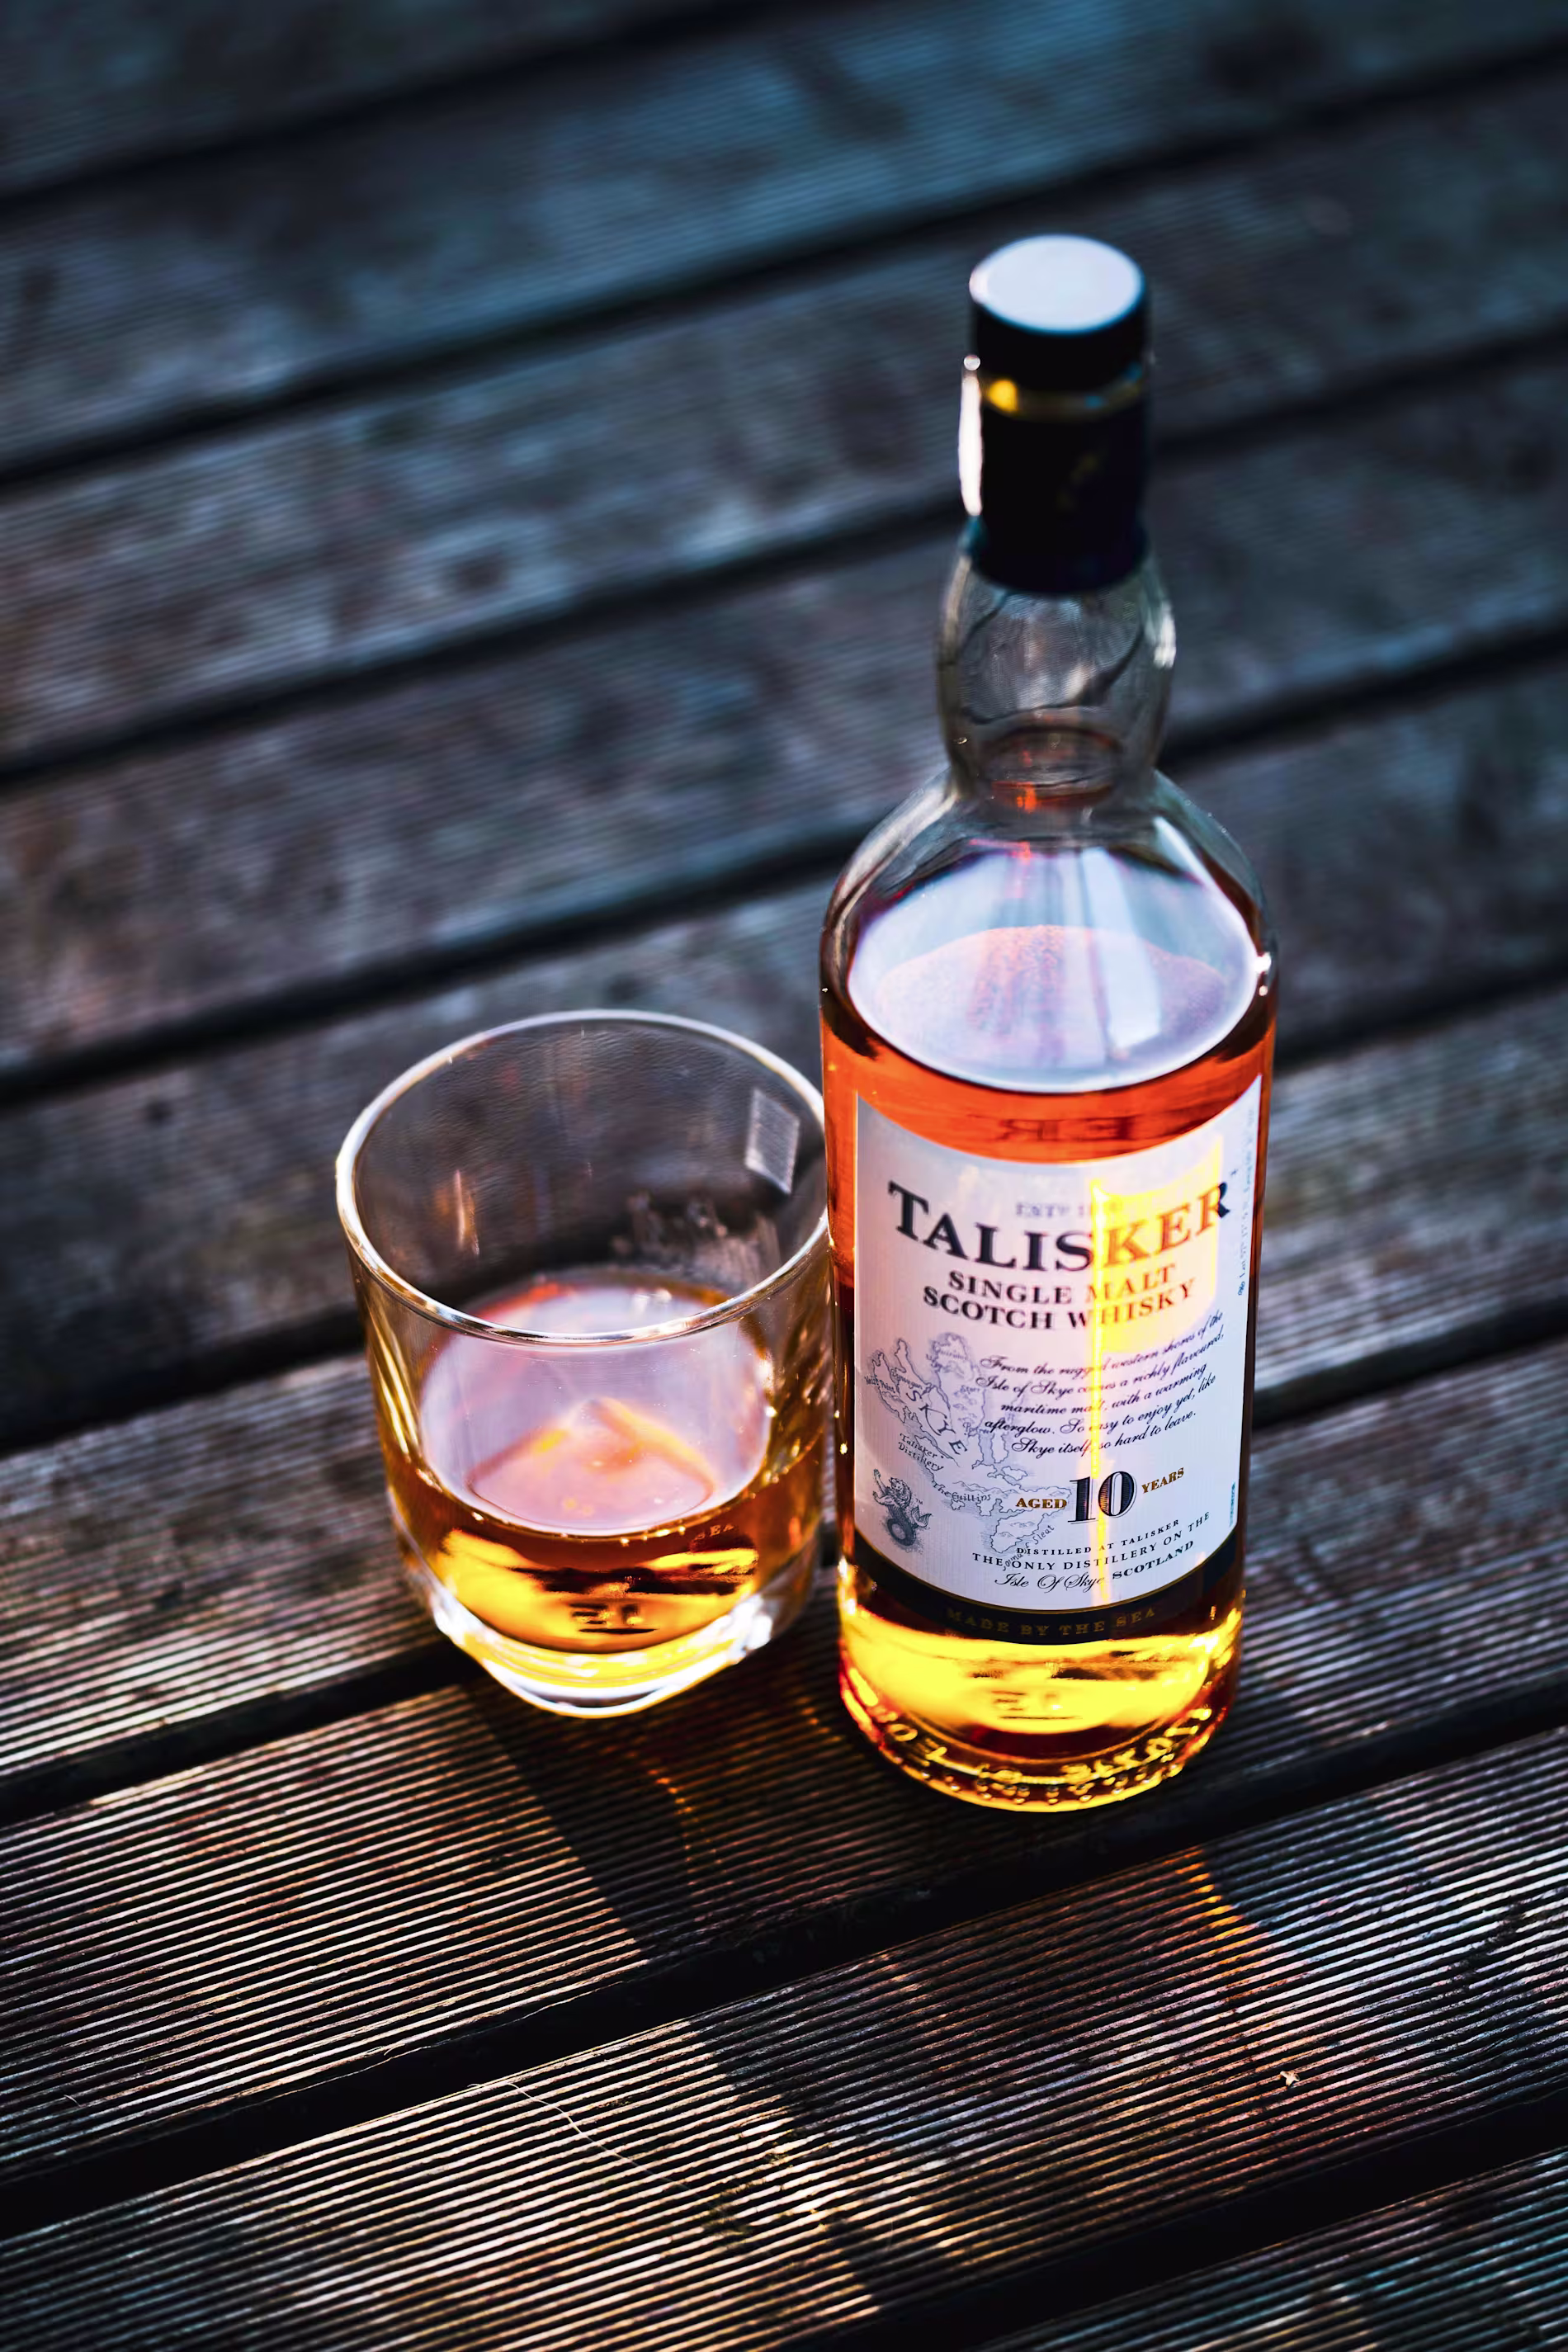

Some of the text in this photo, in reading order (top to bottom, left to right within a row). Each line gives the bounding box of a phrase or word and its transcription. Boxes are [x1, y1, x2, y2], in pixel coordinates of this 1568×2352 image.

[887, 1179, 1230, 1273] TALISKER
[922, 1277, 1196, 1330] SCOTCH WHISKY
[948, 1262, 1177, 1305] SINGLE MALT
[975, 1375, 1010, 1391] Isle
[1013, 1381, 1032, 1399] of
[1031, 1379, 1074, 1400] Skye
[1119, 1379, 1129, 1387] a
[1133, 1361, 1171, 1381] richly
[1170, 1324, 1225, 1376] flavoured,
[980, 1309, 1224, 1380] From the ruggd western shores of the
[984, 1417, 1056, 1438] afterglow.
[1060, 1417, 1084, 1434] So
[1122, 1414, 1135, 1426] to
[1138, 1402, 1173, 1424] enjoy
[1173, 1387, 1196, 1414] yet,
[1197, 1372, 1216, 1394] like
[1000, 1363, 1207, 1415] maritime mat, with a warming
[898, 1442, 945, 1471] Distillery
[900, 1433, 938, 1458] Talisker
[1011, 1436, 1056, 1459] Skye
[1098, 1441, 1112, 1450] so
[1114, 1424, 1150, 1448] hard
[1150, 1424, 1162, 1437] to
[1164, 1410, 1197, 1432] leave.
[1015, 1466, 1185, 1524] AGED 10 YEARS
[972, 1510, 1211, 1570] THE ONLY DISTILLERY ON THE
[1016, 1518, 1180, 1556] DISTILLED AT TALISKER
[1032, 1524, 1055, 1546] Sleat
[994, 1539, 1195, 1594] Isle Of Skye SCOTLAND
[949, 1608, 1156, 1636] MADE BY THE SEA
